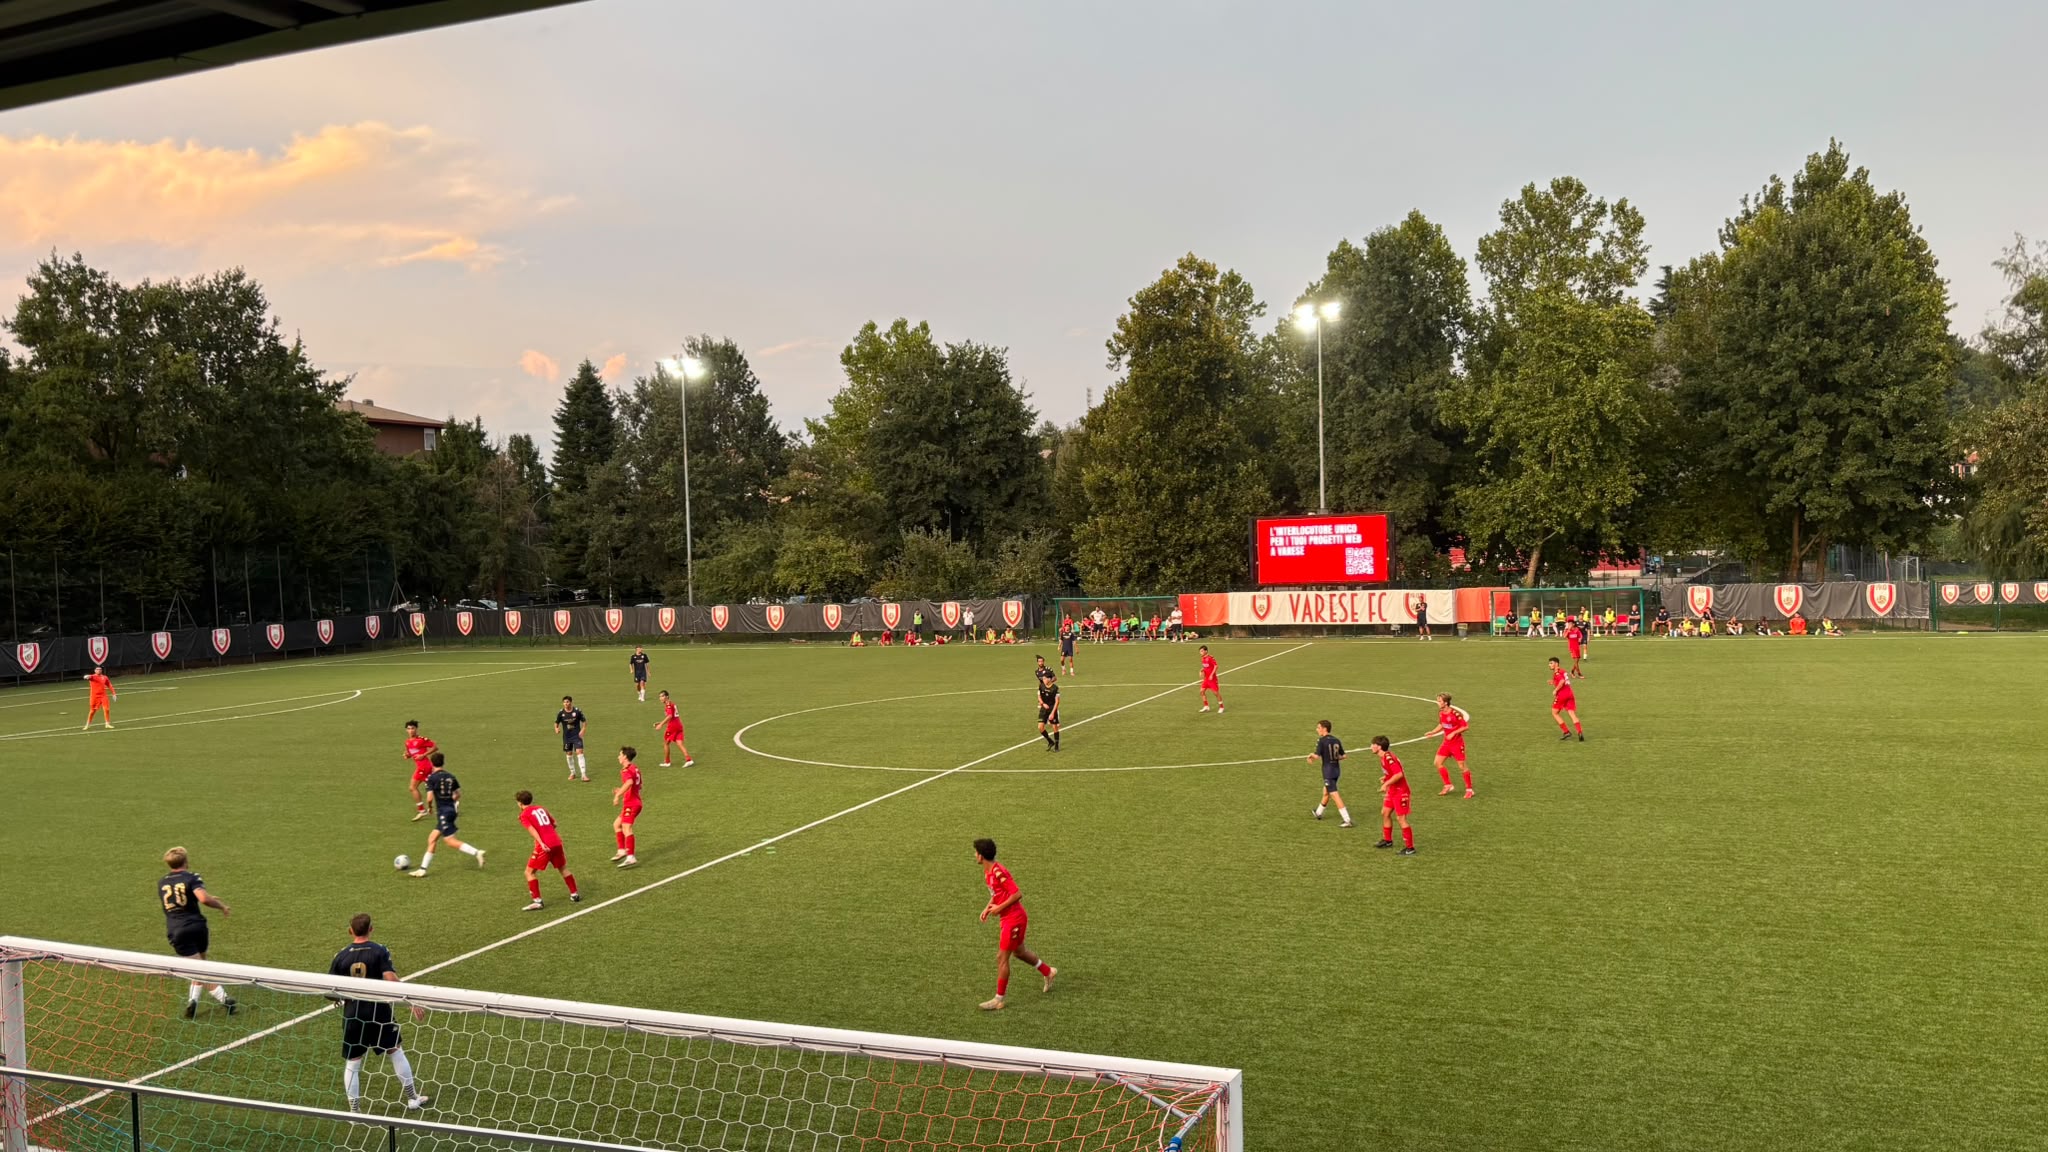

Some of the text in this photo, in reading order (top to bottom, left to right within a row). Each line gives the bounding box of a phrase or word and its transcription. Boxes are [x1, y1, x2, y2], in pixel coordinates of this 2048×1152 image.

[1270, 524, 1358, 537] L'INTERLOCUTORE UNICO
[1270, 536, 1284, 546] PER
[1290, 535, 1307, 546] TUOI
[1308, 534, 1344, 545] PROGETTI
[1345, 533, 1362, 544] WEB
[1270, 546, 1305, 556] A VARESE
[1288, 592, 1388, 623] VARESE FC
[1328, 743, 1340, 760] 18
[531, 808, 550, 826] 18
[161, 883, 187, 910] 20
